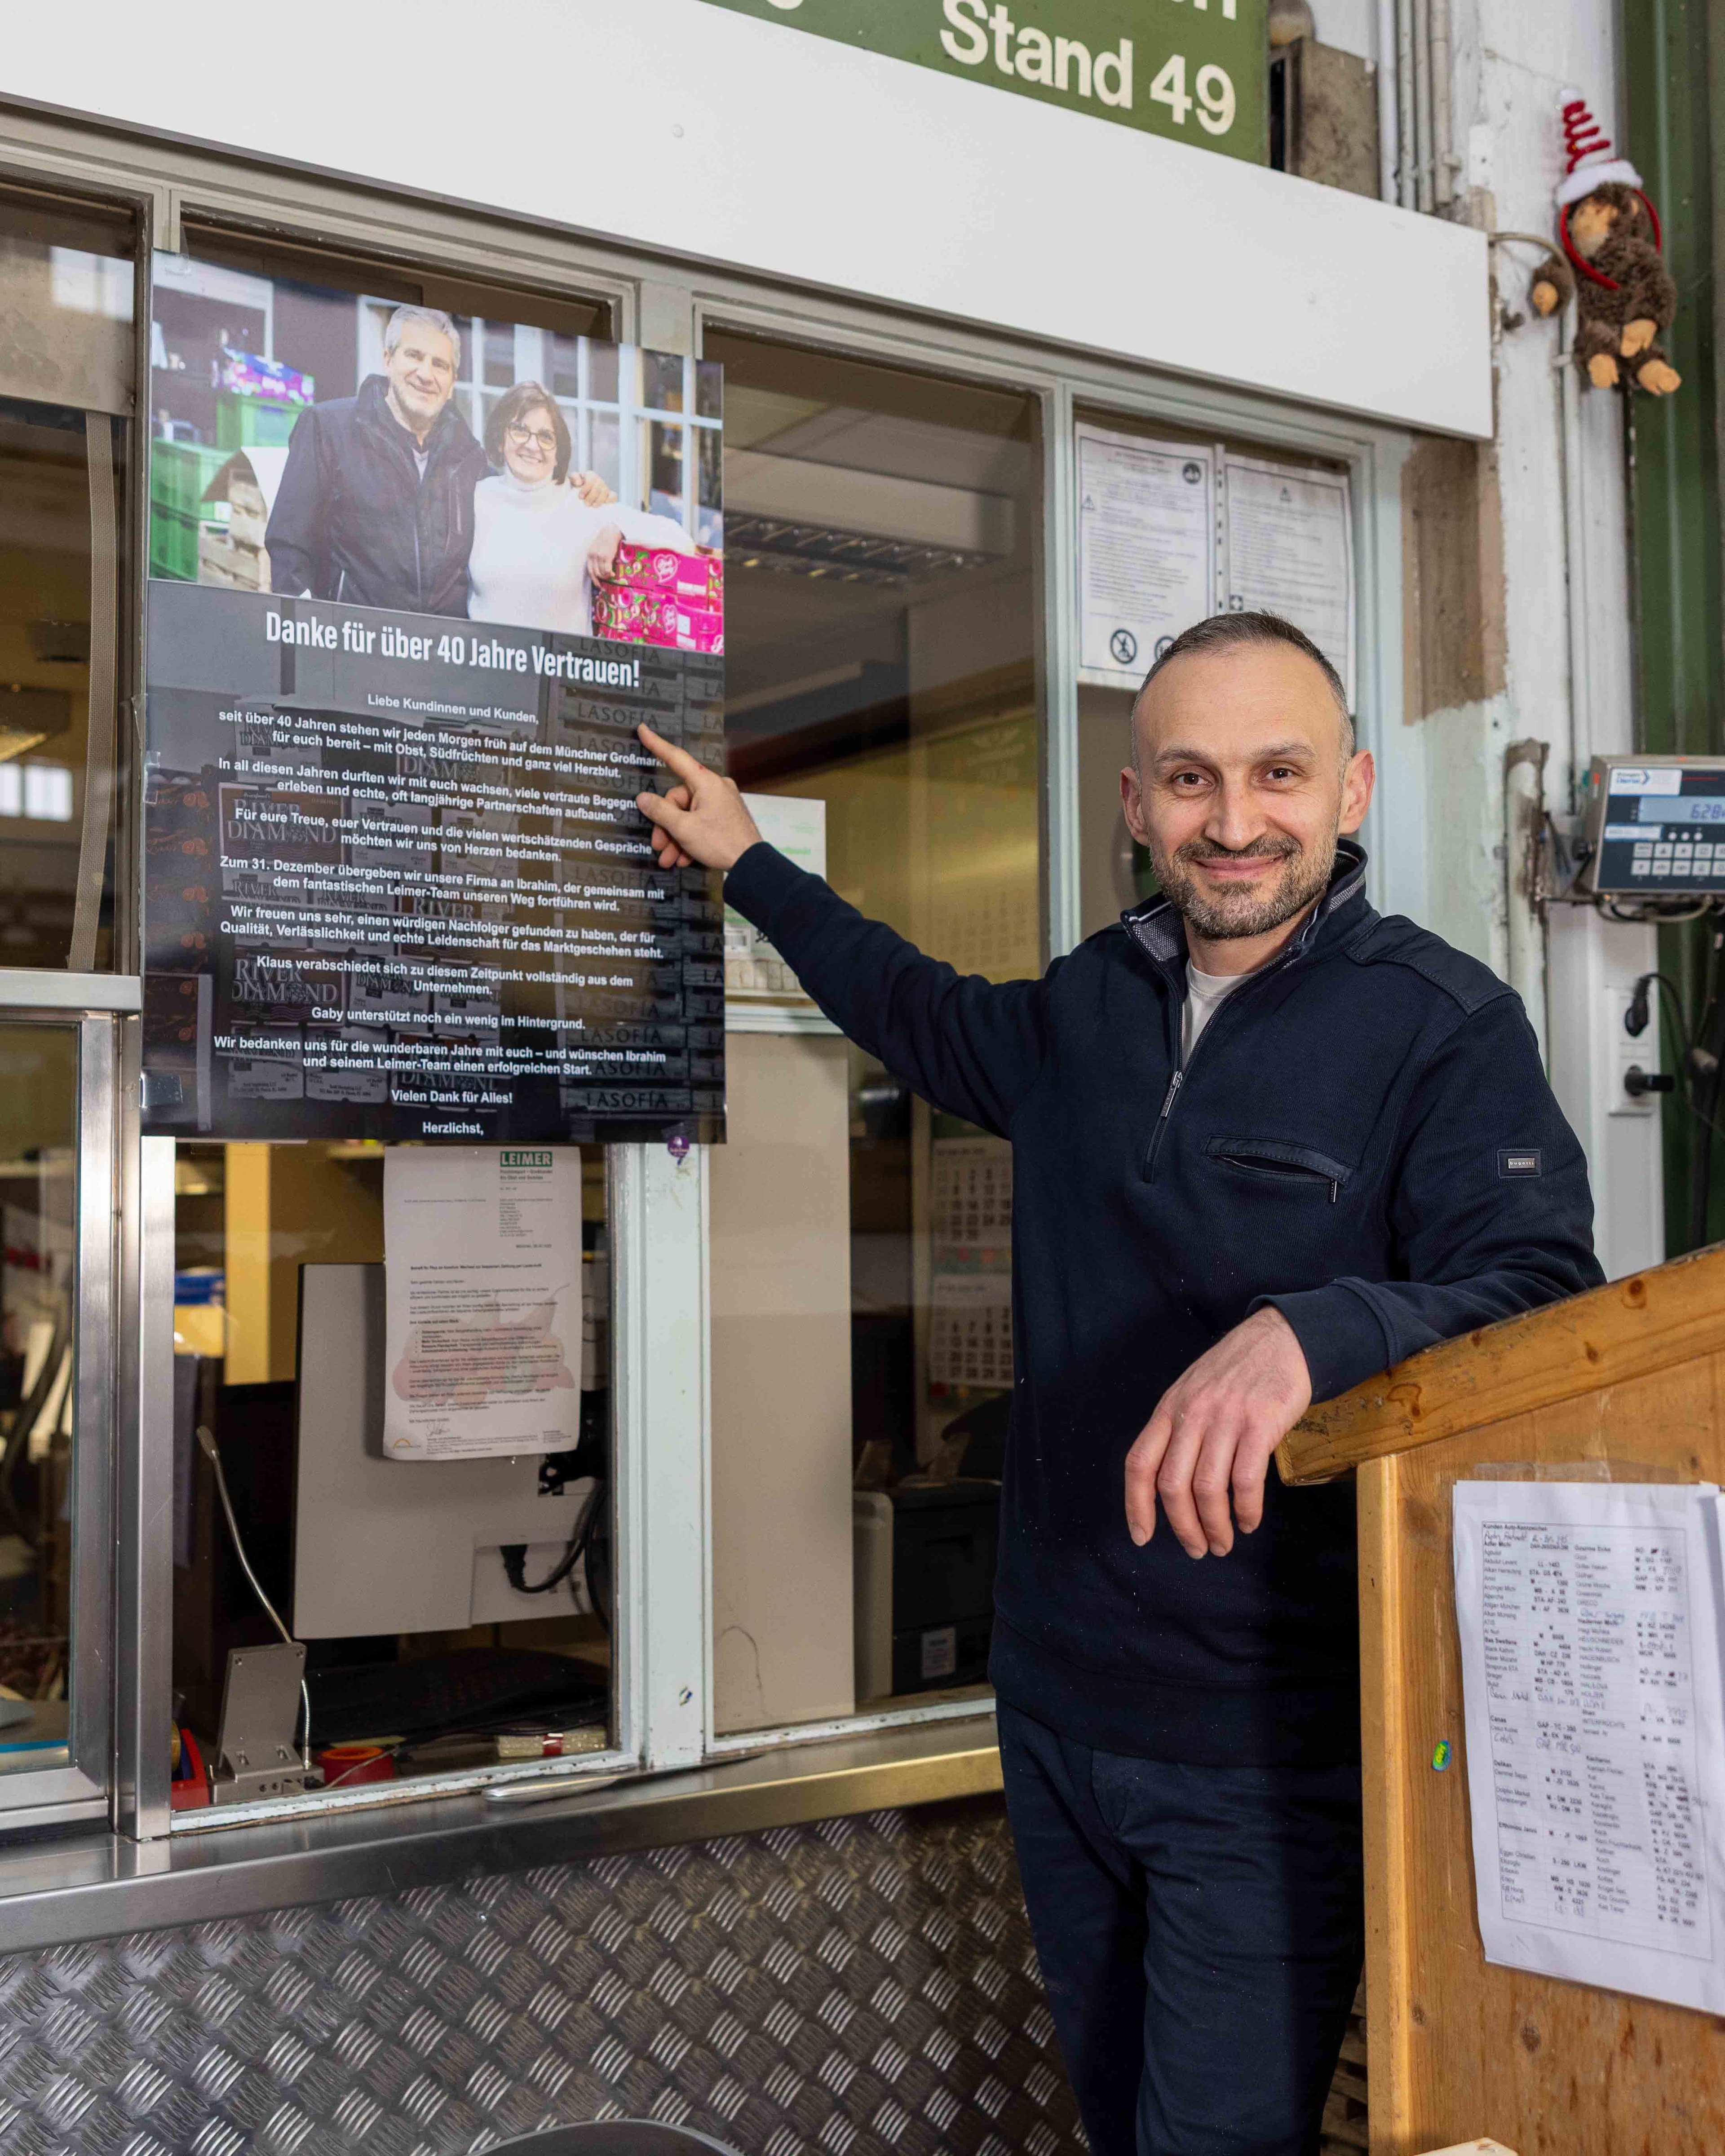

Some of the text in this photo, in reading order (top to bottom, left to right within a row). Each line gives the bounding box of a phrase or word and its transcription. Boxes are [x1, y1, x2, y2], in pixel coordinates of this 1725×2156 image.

[940, 0, 1236, 135] Stand 49
[267, 612, 639, 687] Danke für über 40 Jahre Vertrauen!
[368, 694, 538, 725] Liebe Kundinnen und Kunden,
[219, 711, 242, 722] seit
[246, 712, 274, 725] über
[277, 715, 291, 727] 40
[295, 717, 336, 732] Jahren
[340, 723, 379, 736] stehen
[383, 727, 401, 738] wir
[403, 729, 435, 742] jeden
[439, 732, 481, 748] Morgen
[484, 737, 506, 750] früh
[509, 741, 527, 752] auf
[530, 743, 552, 755] dem
[555, 746, 607, 761] Münchner
[273, 730, 290, 742] für
[293, 735, 323, 746] euch
[327, 736, 360, 750] bereit
[374, 742, 392, 753] mit
[396, 743, 426, 759] Obst,
[430, 747, 498, 764] Südfrüchten
[502, 756, 522, 767] und
[525, 760, 551, 770] ganz
[553, 761, 571, 772] viel
[575, 763, 621, 778] Herzblut.
[219, 758, 230, 769] In
[234, 760, 248, 771] all
[252, 761, 293, 775] diesen
[297, 765, 338, 779] Jahren
[342, 770, 384, 783] durften
[388, 774, 406, 786] wir
[409, 777, 427, 788] mit
[430, 780, 457, 791] euch
[461, 783, 512, 798] wachsen,
[515, 787, 540, 800] viele
[543, 792, 590, 804] vertraute
[236, 807, 651, 854] Für eure Treue, euer Vertrauen und die vielen wertschätzenden Gespräche
[220, 855, 664, 899] Zum 31. Dezember übergeben wir unsere Firma an Ibrahim, der gemeinsam mit
[221, 921, 663, 958] Qualität, Verlässlichkeit und echte Leidenschaft für das Marktgeschehen steht.
[231, 905, 655, 943] Wir freuen uns sehr, einen würdigen Nachfolger gefunden zu haben, der für
[257, 955, 632, 986] Klaus verabschiedet sich zu diesem Zeitpunkt vollständig aus dem
[414, 980, 492, 994] Unternehmen.
[312, 1007, 585, 1030] Gaby unterstützt noch ein wenig im Hintergrund.
[214, 1036, 665, 1062] Wir bedanken uns für die wunderbaren Jahre mit euch und wünschen Ibrahim
[303, 1056, 591, 1075] und seinem Leimer-Team einen erfolgreichen Start.
[392, 1090, 512, 1103] Vielen Dank für Alles!
[423, 1122, 483, 1135] Herzlichst,
[502, 1153, 551, 1165] LEIMER
